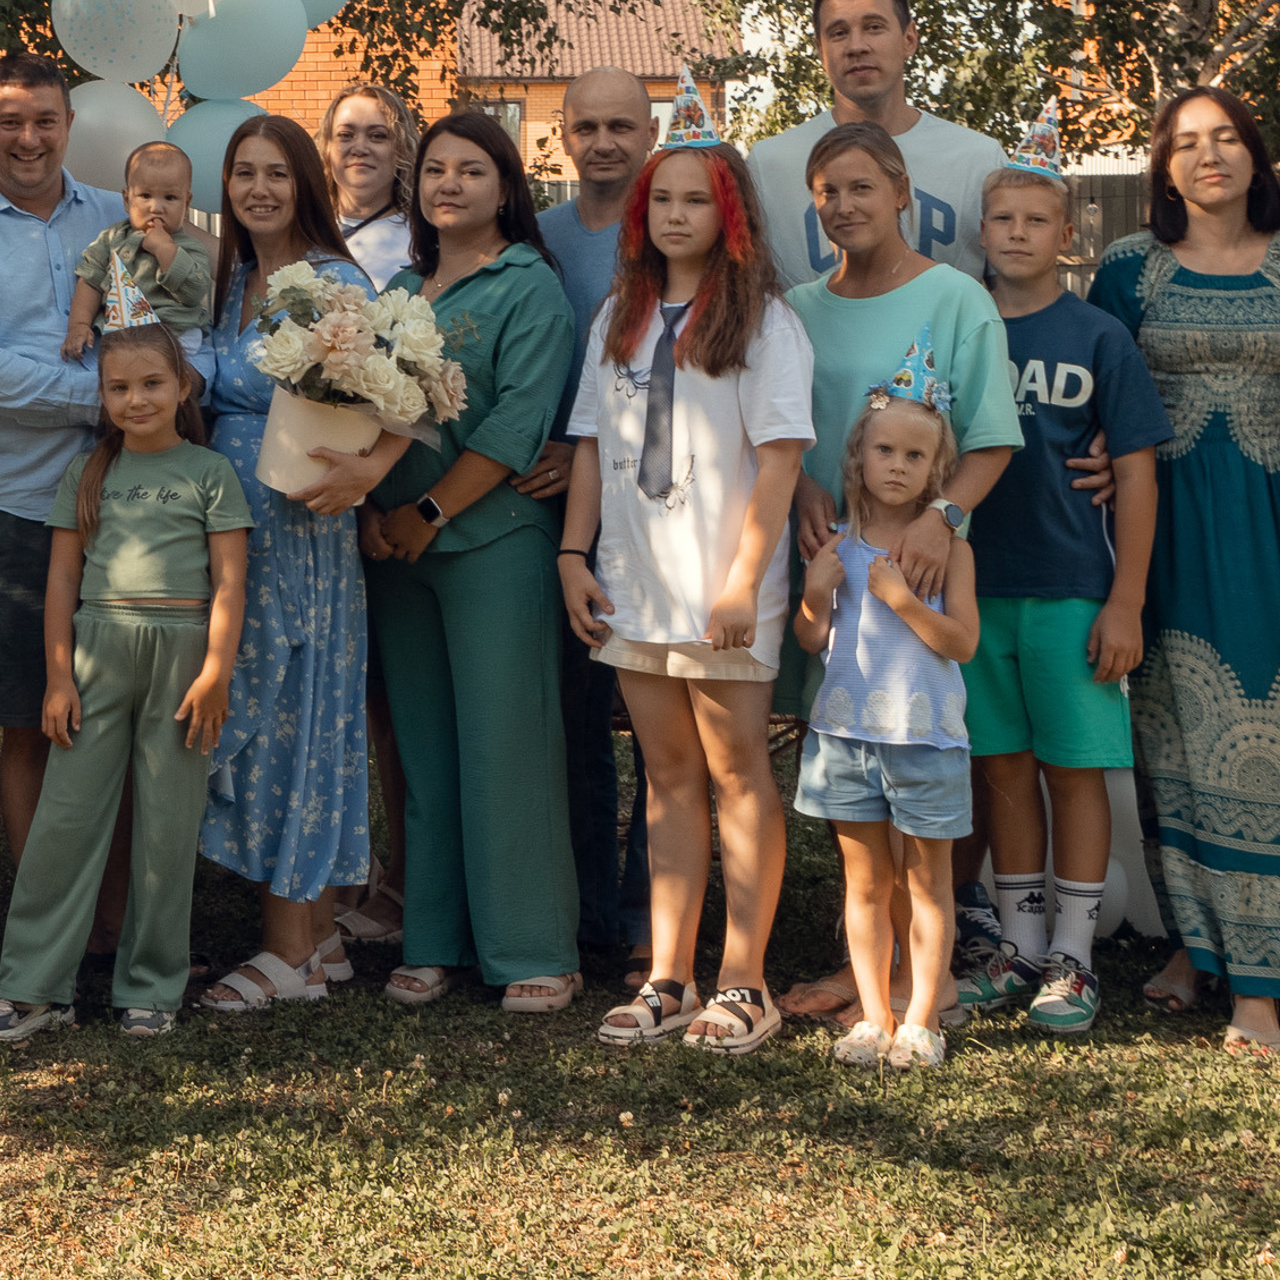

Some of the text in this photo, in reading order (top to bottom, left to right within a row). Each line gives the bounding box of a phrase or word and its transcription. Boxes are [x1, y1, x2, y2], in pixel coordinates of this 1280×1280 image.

[612, 457, 638, 471] butter
[126, 484, 151, 502] the
[156, 486, 182, 504] life
